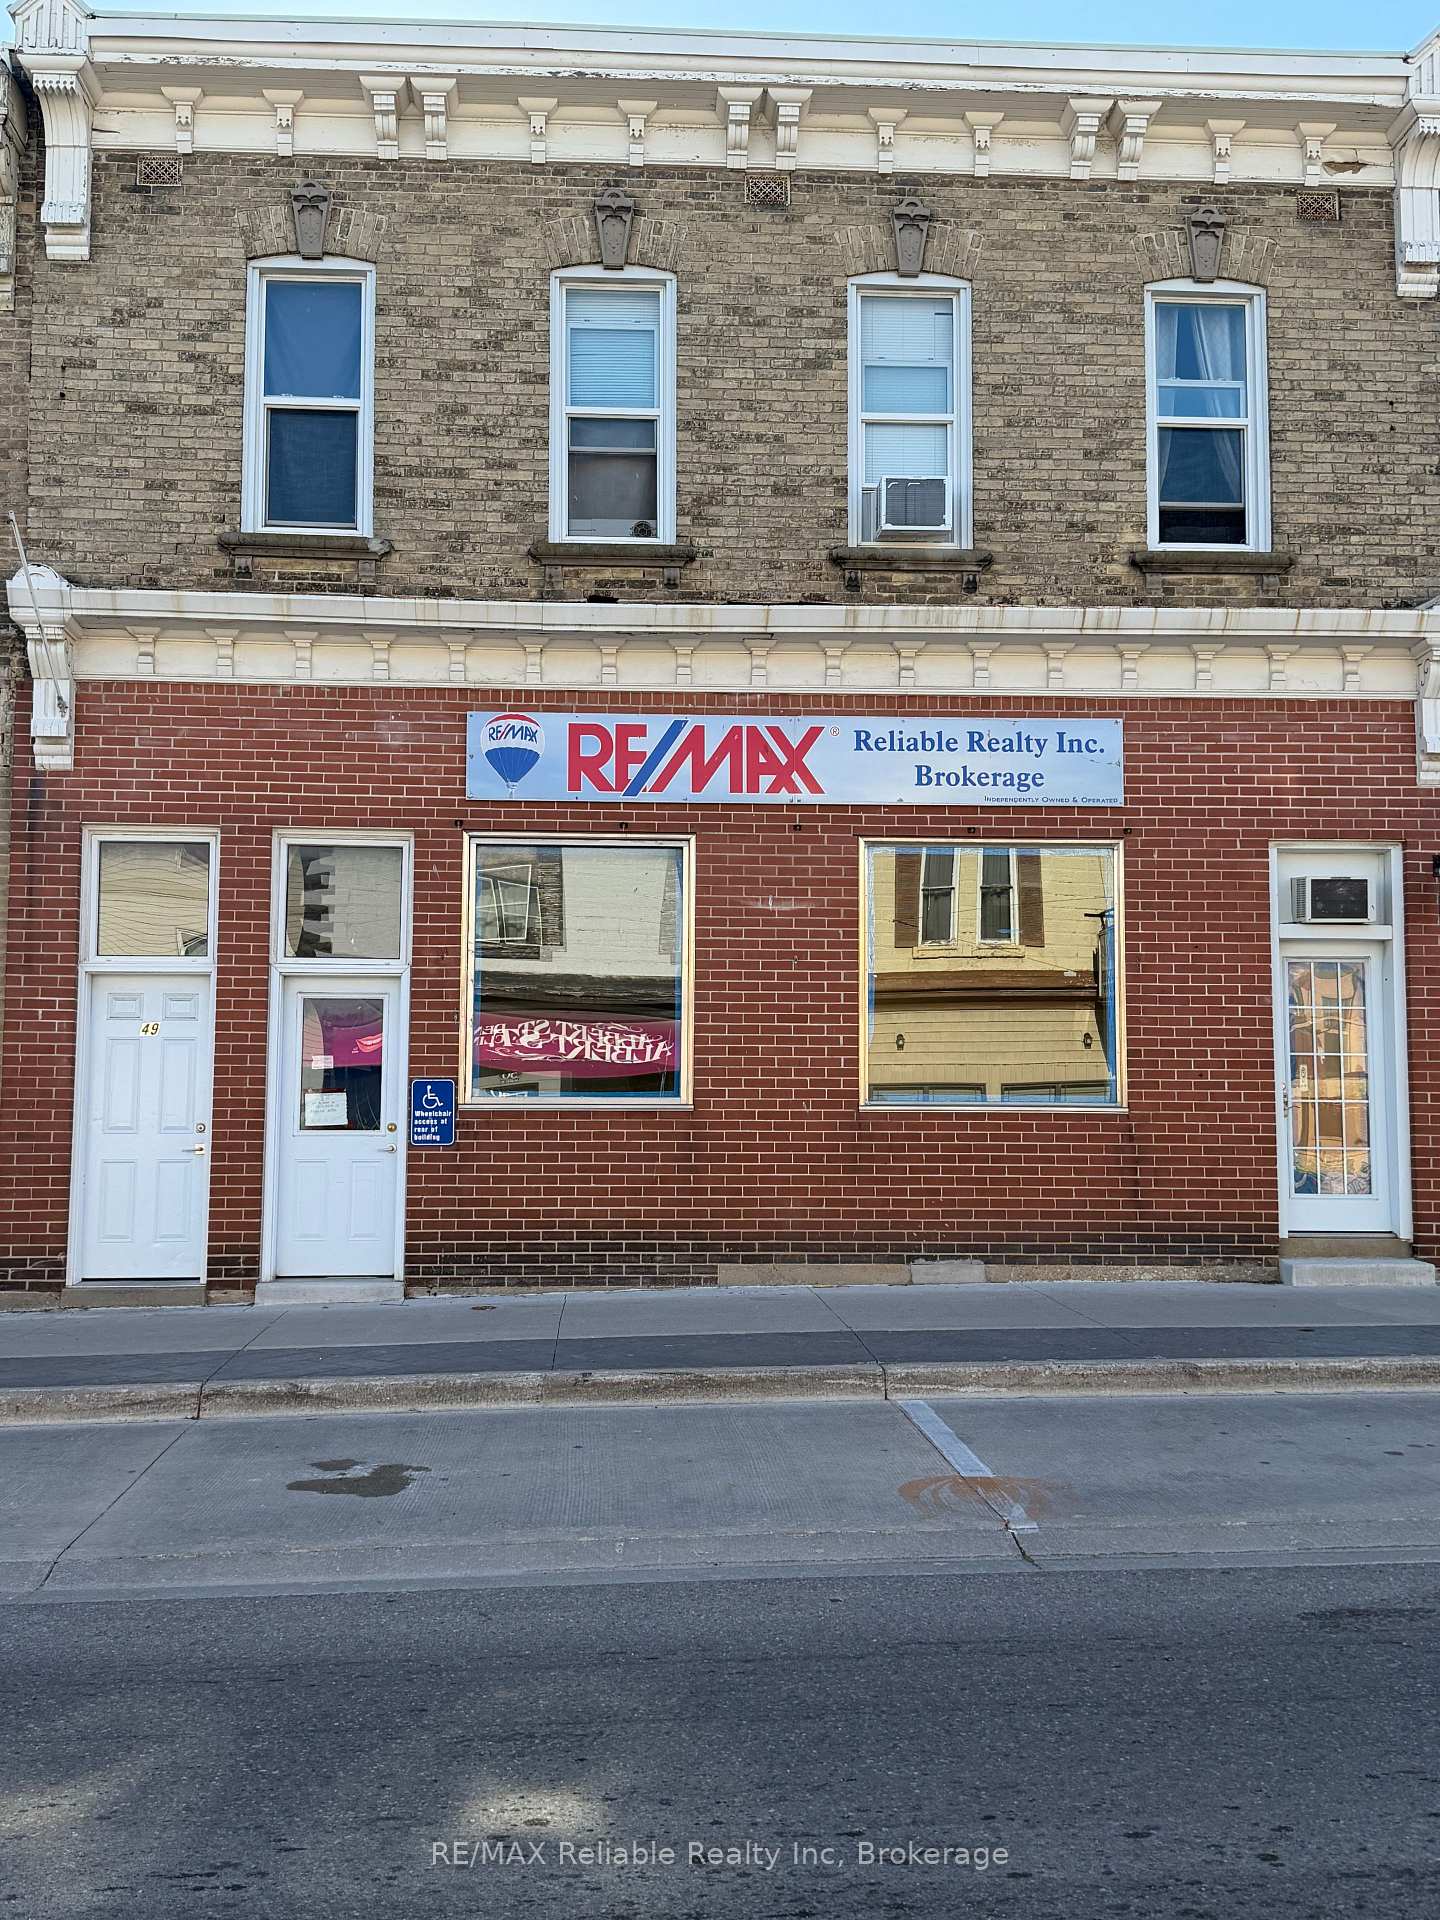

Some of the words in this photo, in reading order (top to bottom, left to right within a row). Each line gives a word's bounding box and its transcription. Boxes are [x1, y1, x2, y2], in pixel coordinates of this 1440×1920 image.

[488, 723, 538, 744] RE/MAX
[854, 730, 959, 753] Reliable
[967, 731, 1048, 758] Realty
[1056, 732, 1105, 753] Inc.
[567, 719, 826, 797] RE/MAX
[914, 765, 1044, 792] Brokerage
[141, 1022, 159, 1035] 49
[414, 1133, 440, 1141] building
